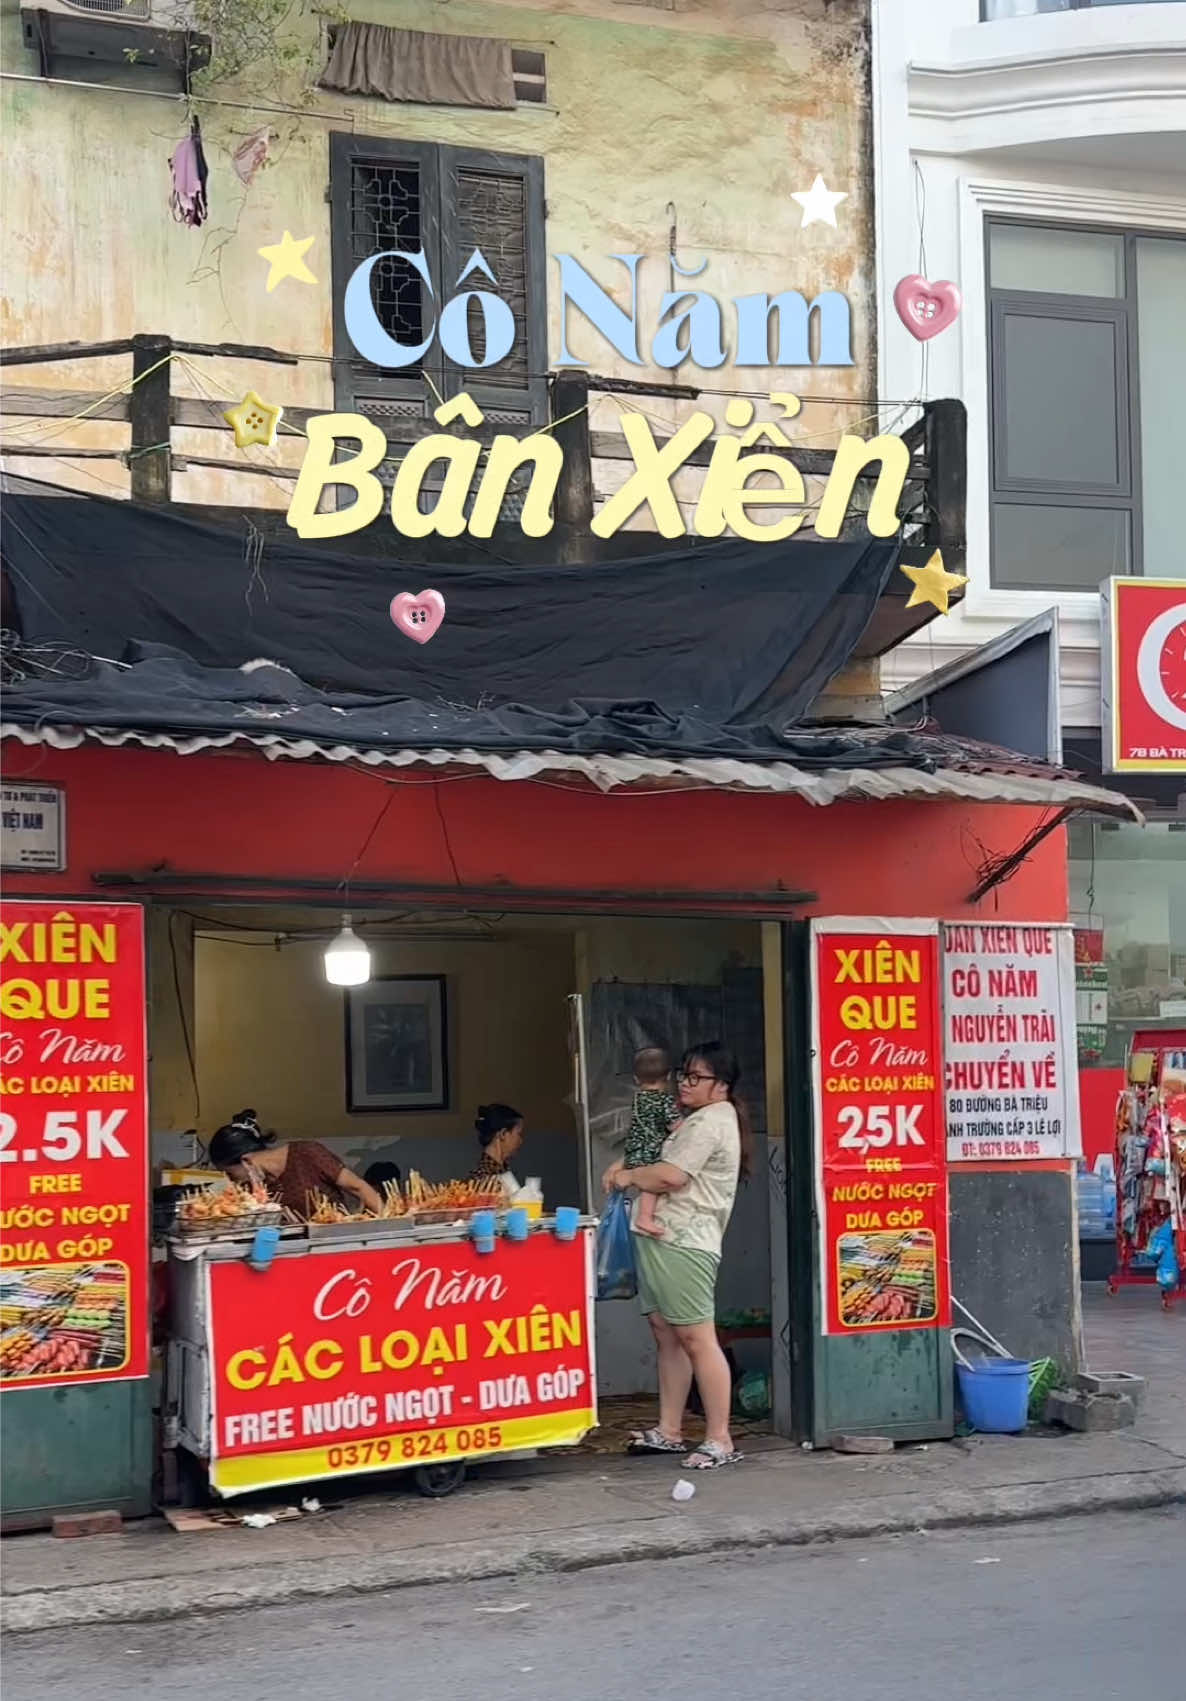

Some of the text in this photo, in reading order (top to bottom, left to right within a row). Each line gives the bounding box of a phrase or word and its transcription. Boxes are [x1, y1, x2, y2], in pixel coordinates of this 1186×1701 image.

[0, 911, 116, 963] XIÊN
[1023, 928, 1053, 957] QUE
[834, 939, 921, 983] XIÊN
[952, 963, 1038, 998] CÔ NĂM
[0, 978, 110, 1019] QUE
[840, 995, 917, 1030] QUE
[952, 1004, 1017, 1043] NGUYỄN
[39, 1028, 125, 1064] Năm
[830, 1036, 928, 1068] Cô Năm
[31, 1075, 81, 1098] LOẠI
[87, 1070, 135, 1093] XIÊN
[826, 1072, 934, 1095] CÁC LOẠI XIÊN
[945, 1049, 1057, 1090] CHUYỂN VỀ
[1027, 1121, 1034, 1136] 3
[866, 1157, 902, 1173] FREE
[29, 1173, 82, 1194] FREE
[833, 1180, 937, 1202] NƯỚC NGỌT
[61, 1204, 131, 1228] NGỌT
[846, 1206, 924, 1229] DƯA GÓP
[0, 1233, 113, 1262] DƯA GÓP
[313, 1258, 507, 1321] Cô Năm
[225, 1304, 582, 1391] CÁC LOẠI XIÊN
[225, 1406, 295, 1448] FREE
[303, 1391, 378, 1436] NƯỚC
[385, 1385, 455, 1425] NGỌT
[479, 1373, 530, 1411] DƯA
[537, 1364, 585, 1400] GÓP
[328, 1426, 502, 1469] 0379 824 085
